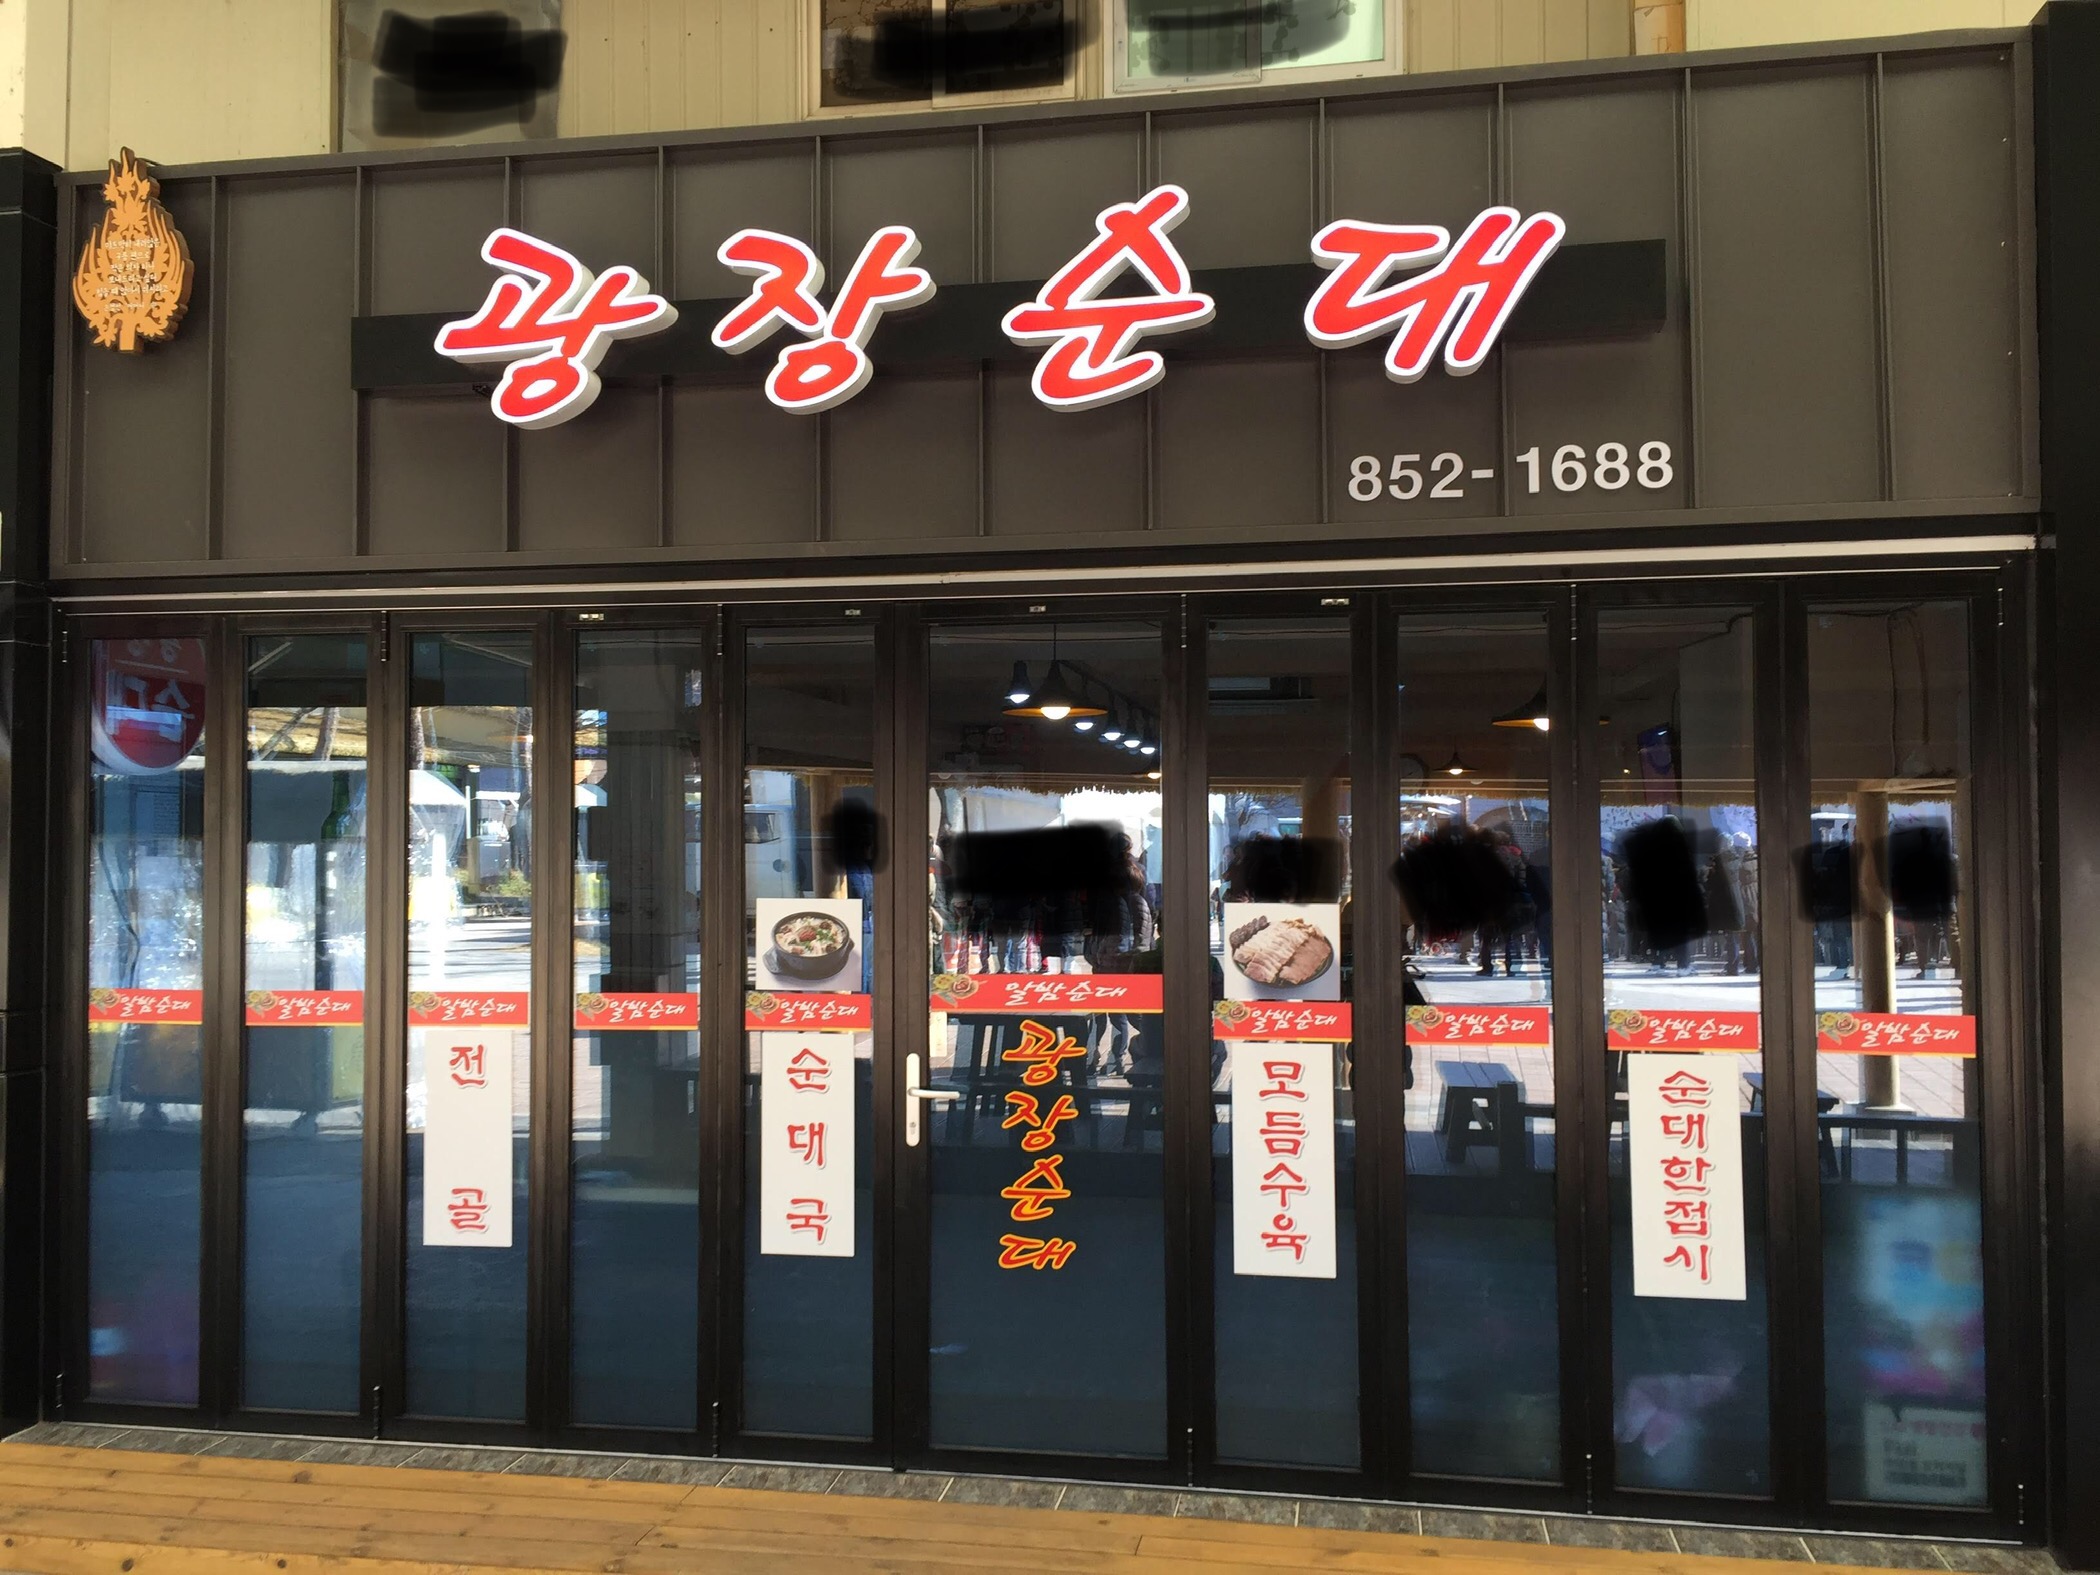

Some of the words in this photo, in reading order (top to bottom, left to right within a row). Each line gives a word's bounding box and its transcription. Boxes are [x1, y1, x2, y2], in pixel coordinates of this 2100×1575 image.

[433, 184, 1567, 430] 광장순대
[448, 1044, 488, 1234] 전골
[785, 1048, 831, 1245] 순대국
[998, 1019, 1088, 1270] 광장순대
[1258, 1060, 1309, 1263] 모듬수육
